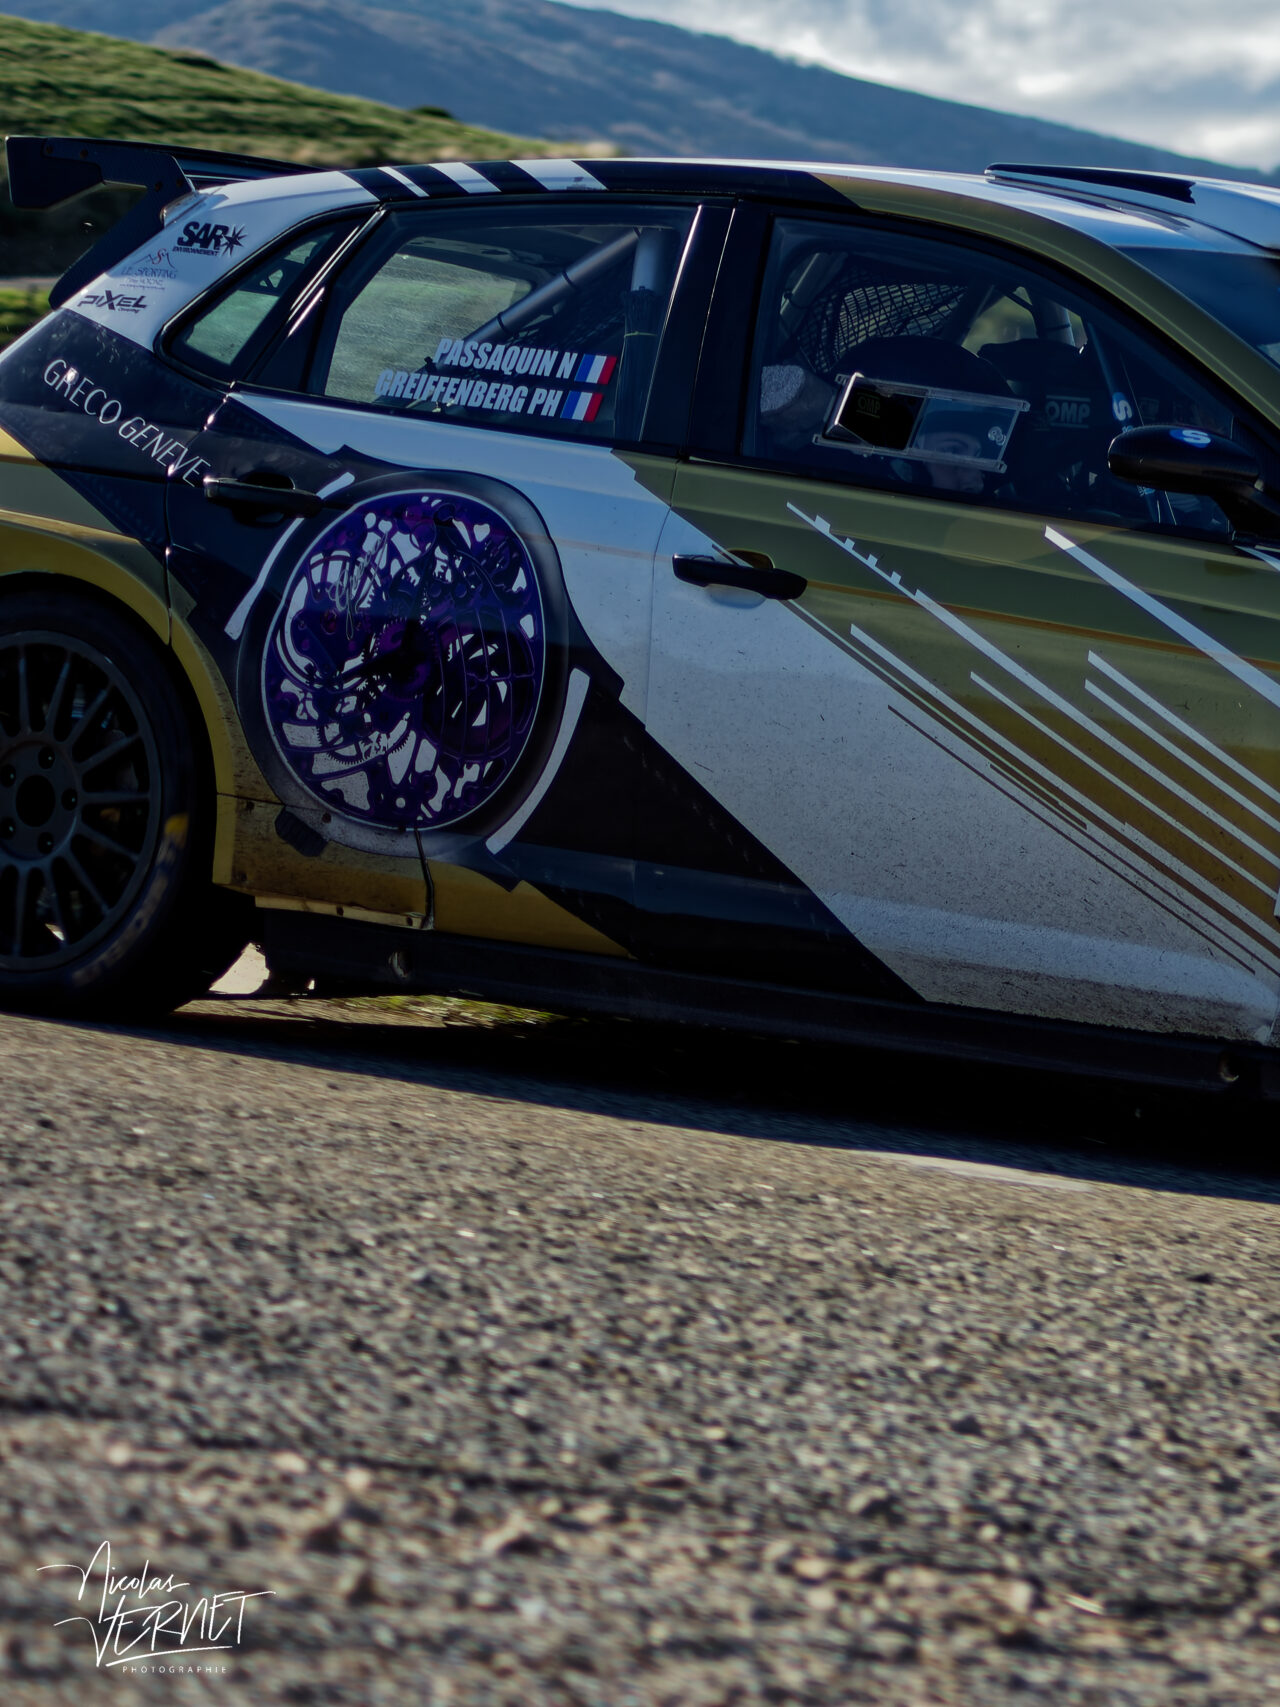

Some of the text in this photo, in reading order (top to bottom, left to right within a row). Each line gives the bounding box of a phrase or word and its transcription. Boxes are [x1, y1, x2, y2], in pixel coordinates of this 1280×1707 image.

[177, 221, 229, 250] SAR
[432, 338, 578, 379] PASSAQUIN N
[374, 369, 563, 417] GREIFFENBERG PH
[1045, 400, 1091, 424] OMP
[44, 359, 212, 488] GRECO GENEVE
